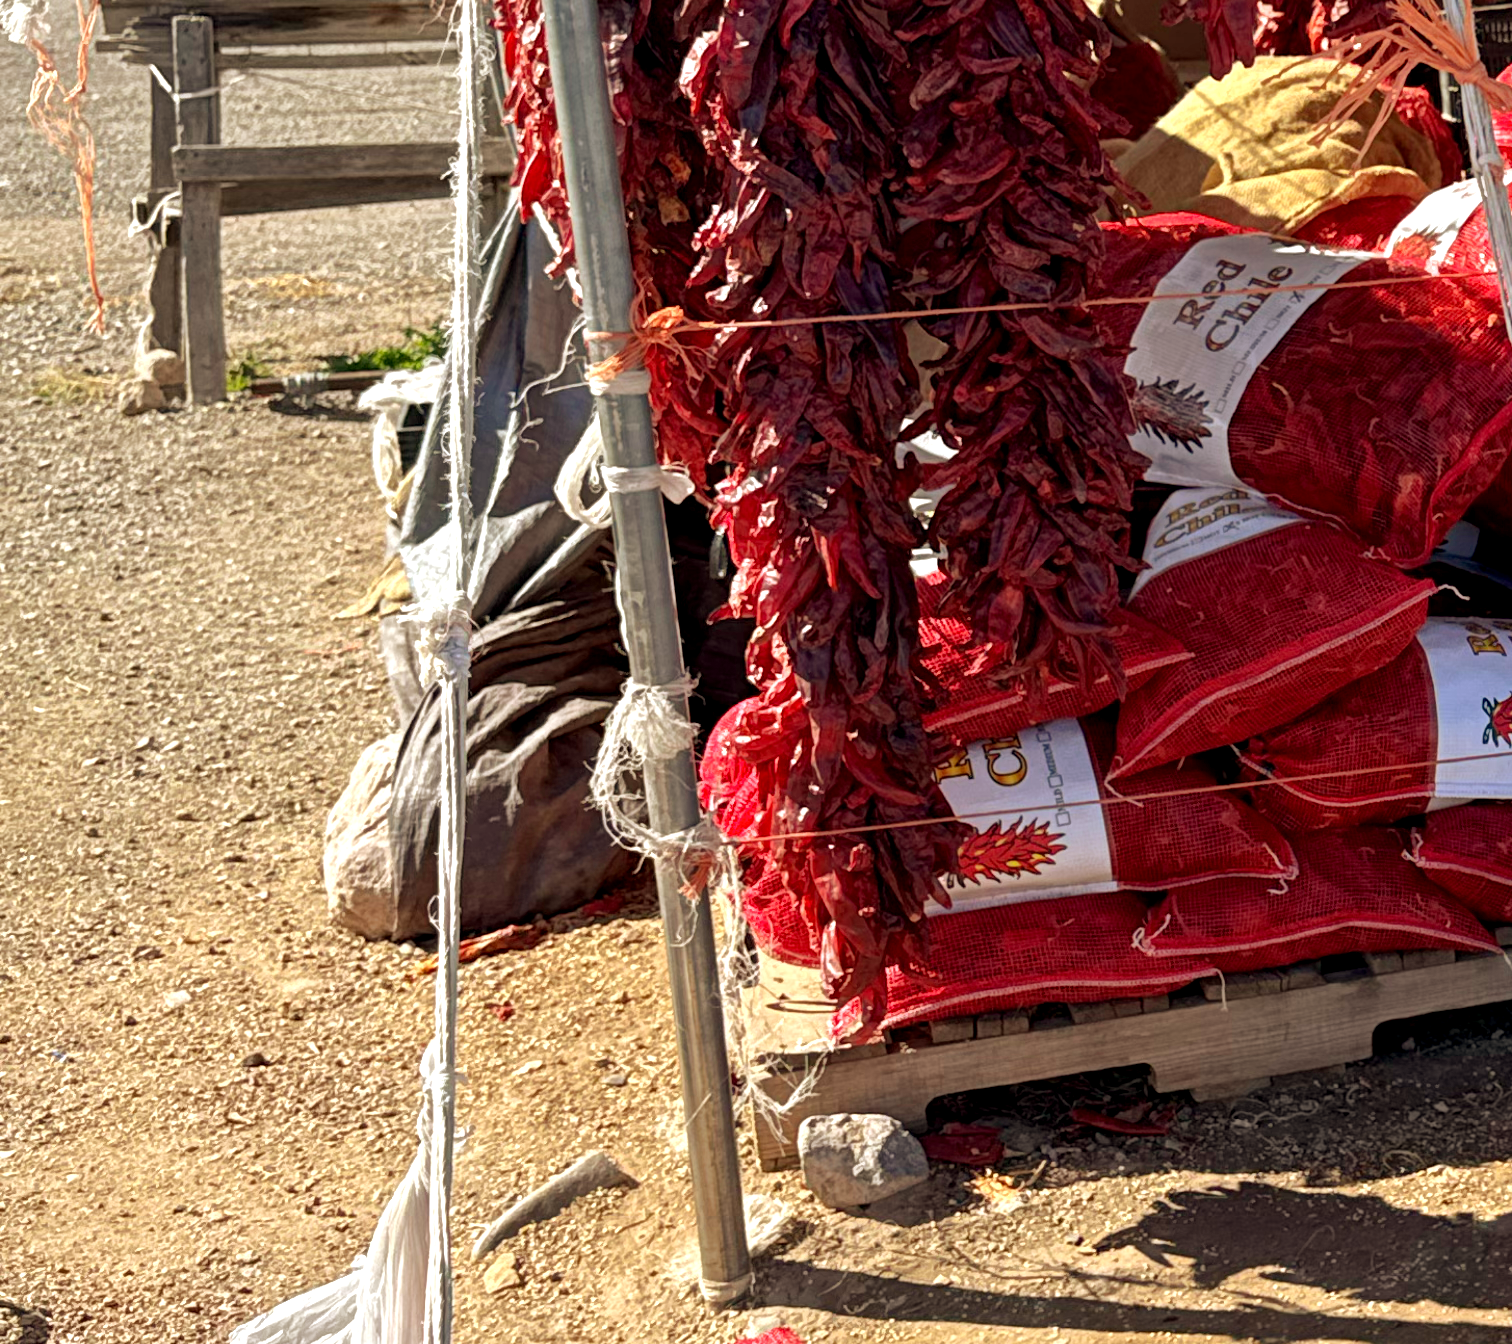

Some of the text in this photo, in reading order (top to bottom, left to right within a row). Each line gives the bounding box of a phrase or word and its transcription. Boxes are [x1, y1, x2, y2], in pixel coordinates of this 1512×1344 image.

[1173, 259, 1247, 331] Red
[1205, 265, 1293, 352] Chile
[1165, 489, 1251, 528] Red
